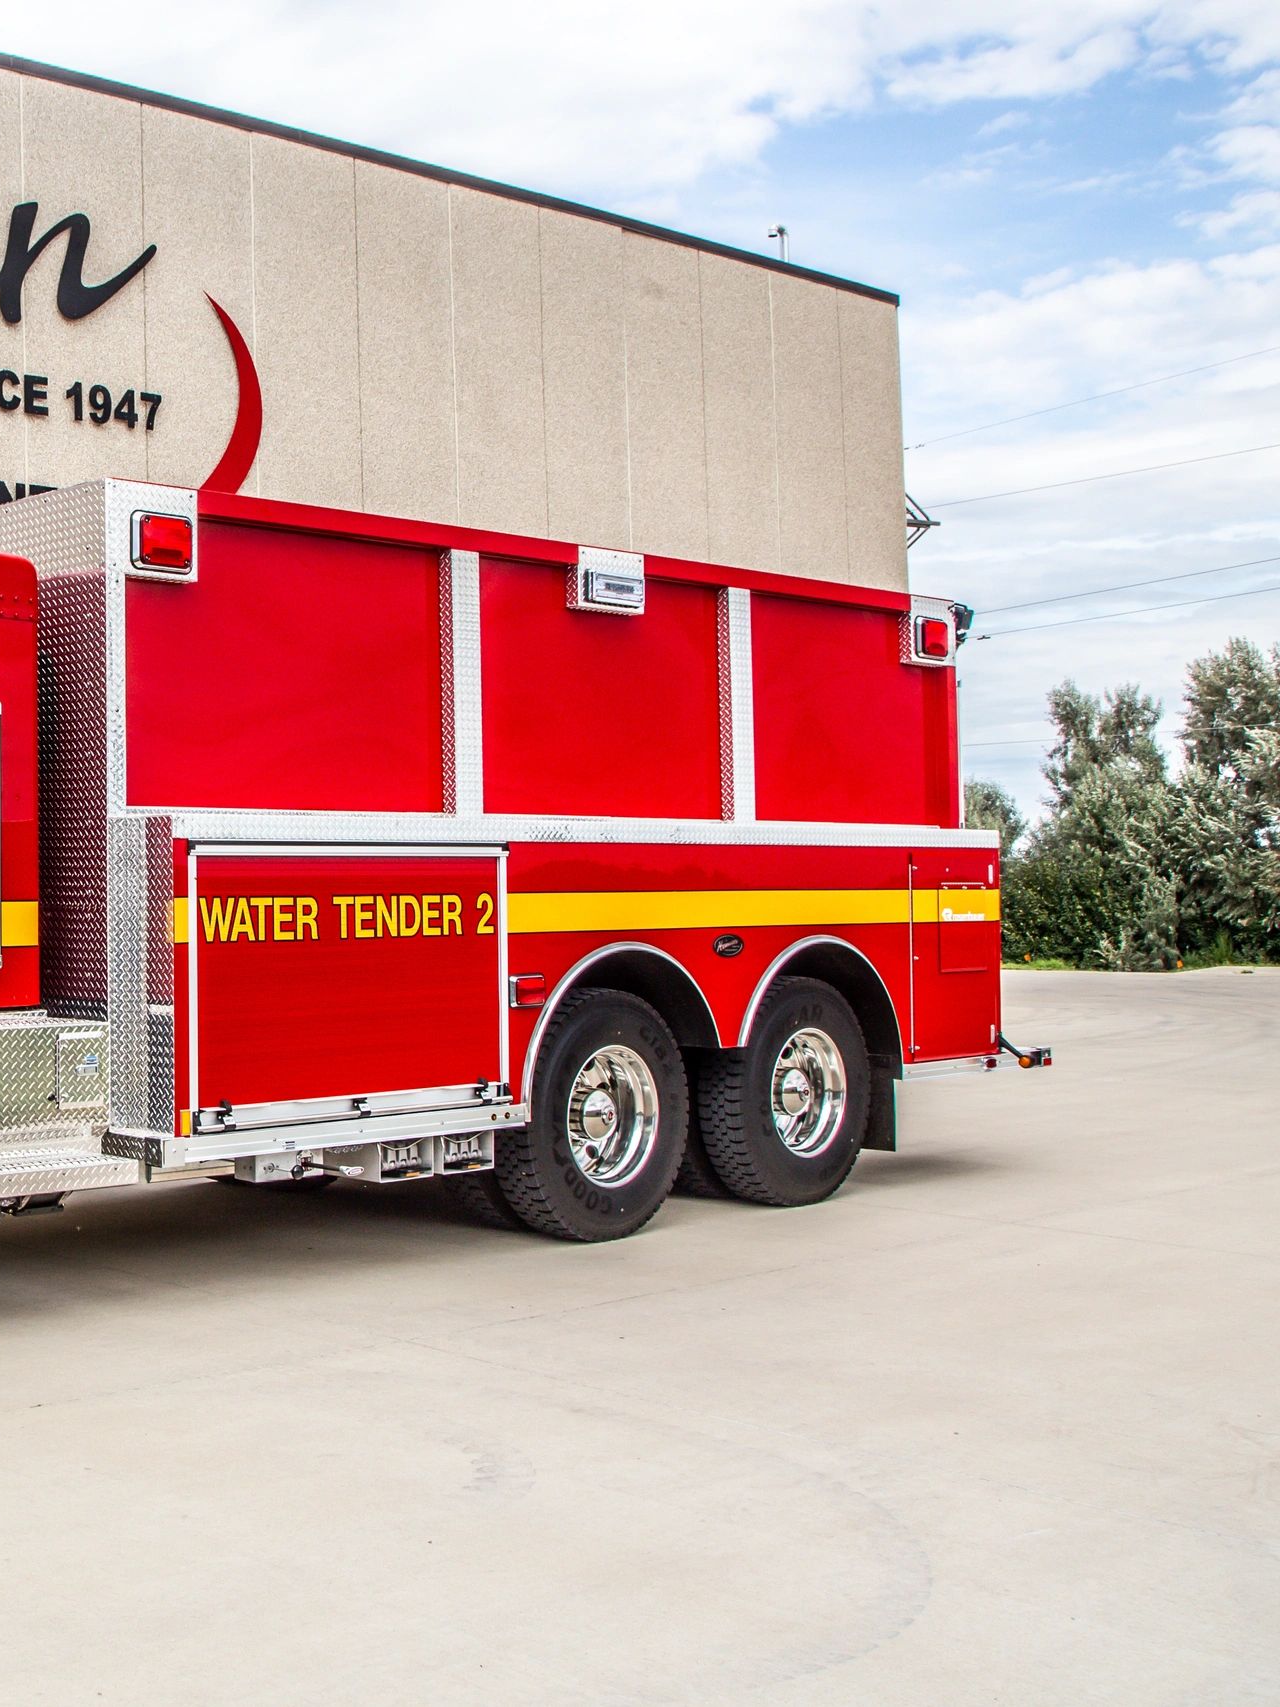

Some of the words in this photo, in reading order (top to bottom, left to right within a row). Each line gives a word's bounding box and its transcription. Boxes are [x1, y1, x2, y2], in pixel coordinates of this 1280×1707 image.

[66, 381, 162, 431] 1947
[199, 897, 319, 942] WATER
[332, 894, 463, 939] TENDER
[476, 892, 495, 935] 2
